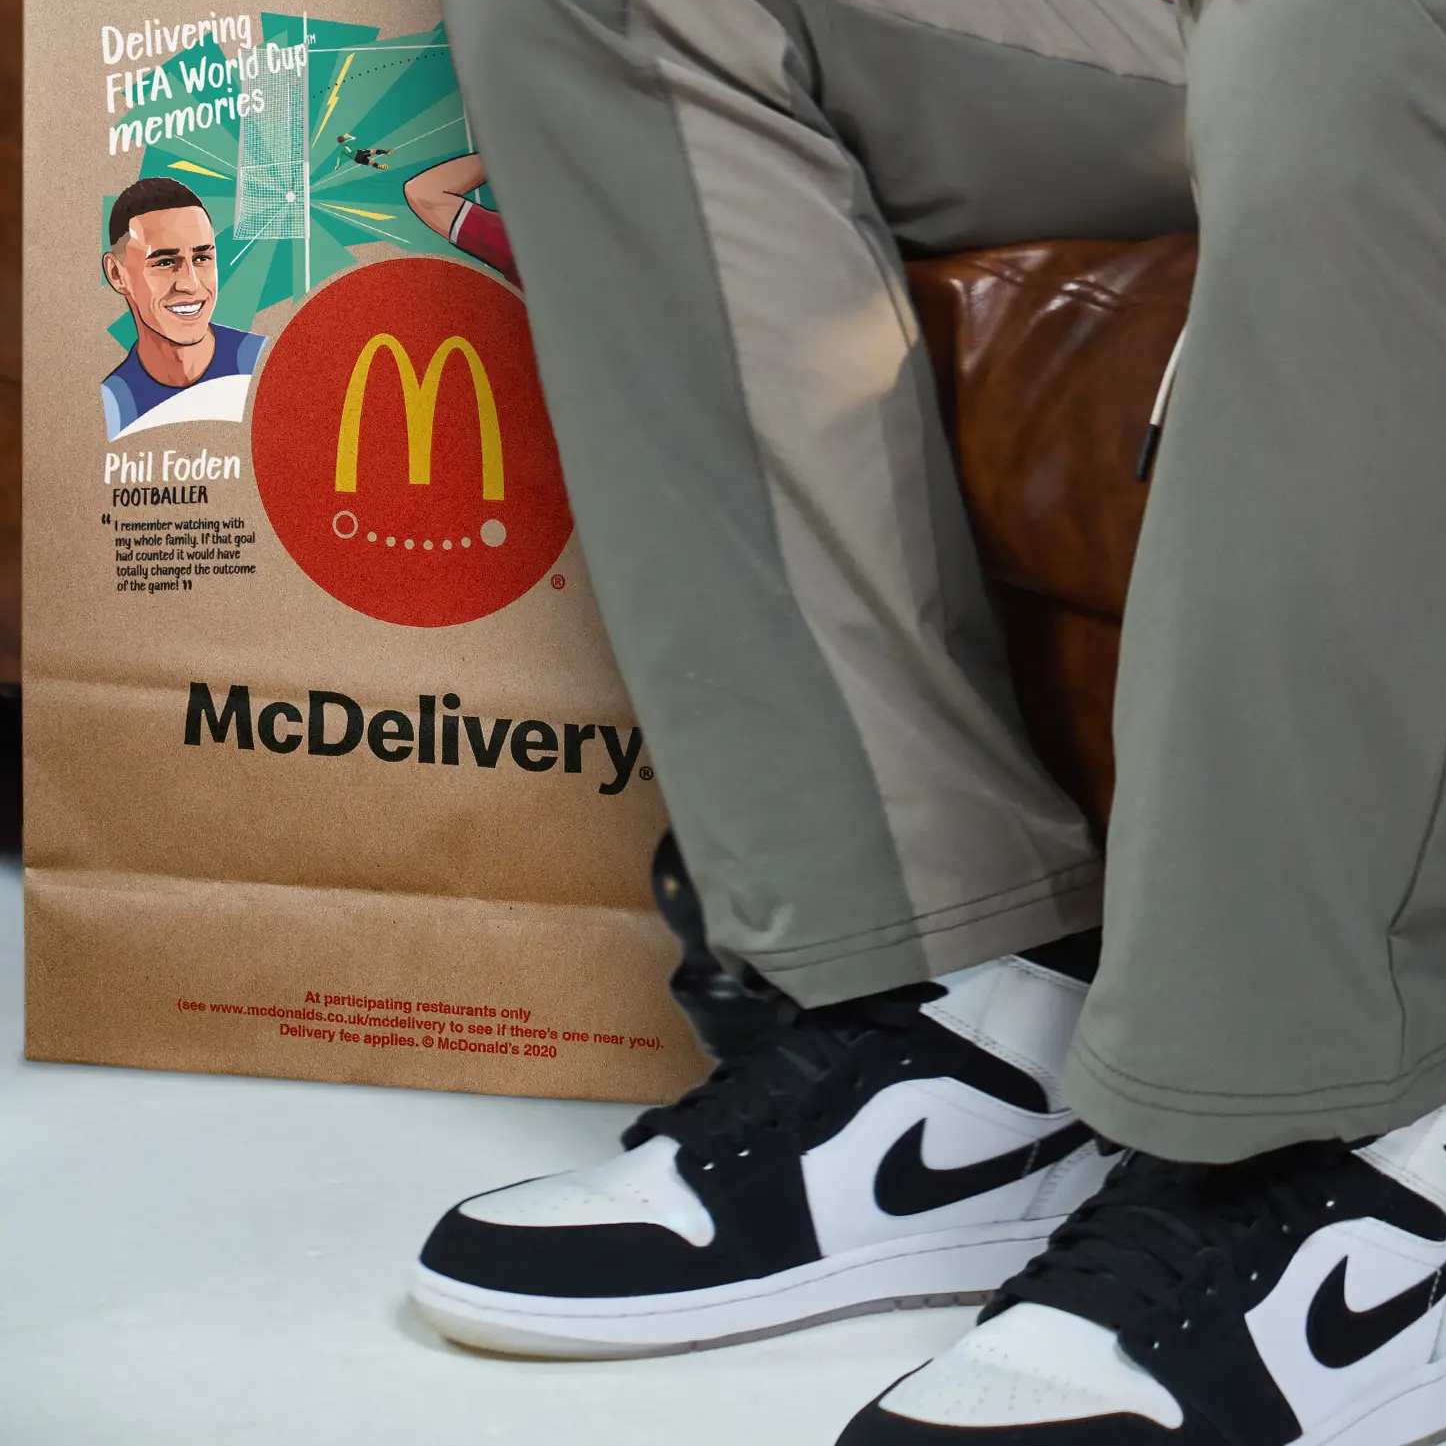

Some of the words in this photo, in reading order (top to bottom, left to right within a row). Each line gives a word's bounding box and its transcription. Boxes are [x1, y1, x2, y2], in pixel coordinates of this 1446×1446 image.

[102, 12, 252, 65] Delivering
[106, 66, 173, 114] FIFA
[179, 46, 258, 94] World
[109, 88, 265, 156] memories
[104, 451, 153, 485] Phil
[162, 449, 241, 482] Foden
[112, 485, 209, 507] FOOTBALLER
[115, 537, 131, 550] my
[133, 534, 163, 546] whole
[165, 533, 199, 548] family.
[201, 533, 211, 545] If
[211, 532, 232, 545] that
[234, 532, 256, 547] goal
[120, 519, 173, 531] remember
[174, 518, 220, 533] watching
[222, 517, 245, 529] with
[116, 550, 133, 561] had
[135, 549, 175, 561] counted
[176, 549, 185, 560] it
[187, 548, 215, 560] would
[217, 548, 241, 560] have
[116, 565, 149, 580] totally
[150, 564, 192, 579] changed
[194, 564, 211, 575] the
[213, 565, 257, 576] outcome
[117, 580, 129, 592] of
[130, 580, 147, 591] the
[148, 580, 179, 594] game!
[305, 990, 321, 1004] At
[323, 993, 412, 1014] participating
[416, 1001, 497, 1018] restaurants
[500, 1007, 531, 1023] only
[177, 997, 206, 1013] (see
[209, 1002, 446, 1035] www.mcdonalds.co.uk/mcdelivery
[449, 1020, 464, 1034] to
[467, 1024, 494, 1036] see
[497, 1023, 507, 1037] if
[510, 1024, 558, 1040] there's
[562, 1030, 589, 1042] one
[593, 1032, 625, 1046] near
[628, 1035, 665, 1050] you).
[279, 1023, 336, 1043] Delivery
[339, 1028, 361, 1043] fee
[363, 1032, 420, 1049] applies.
[437, 1036, 520, 1056] McDonald's
[523, 1042, 558, 1059] 2020
